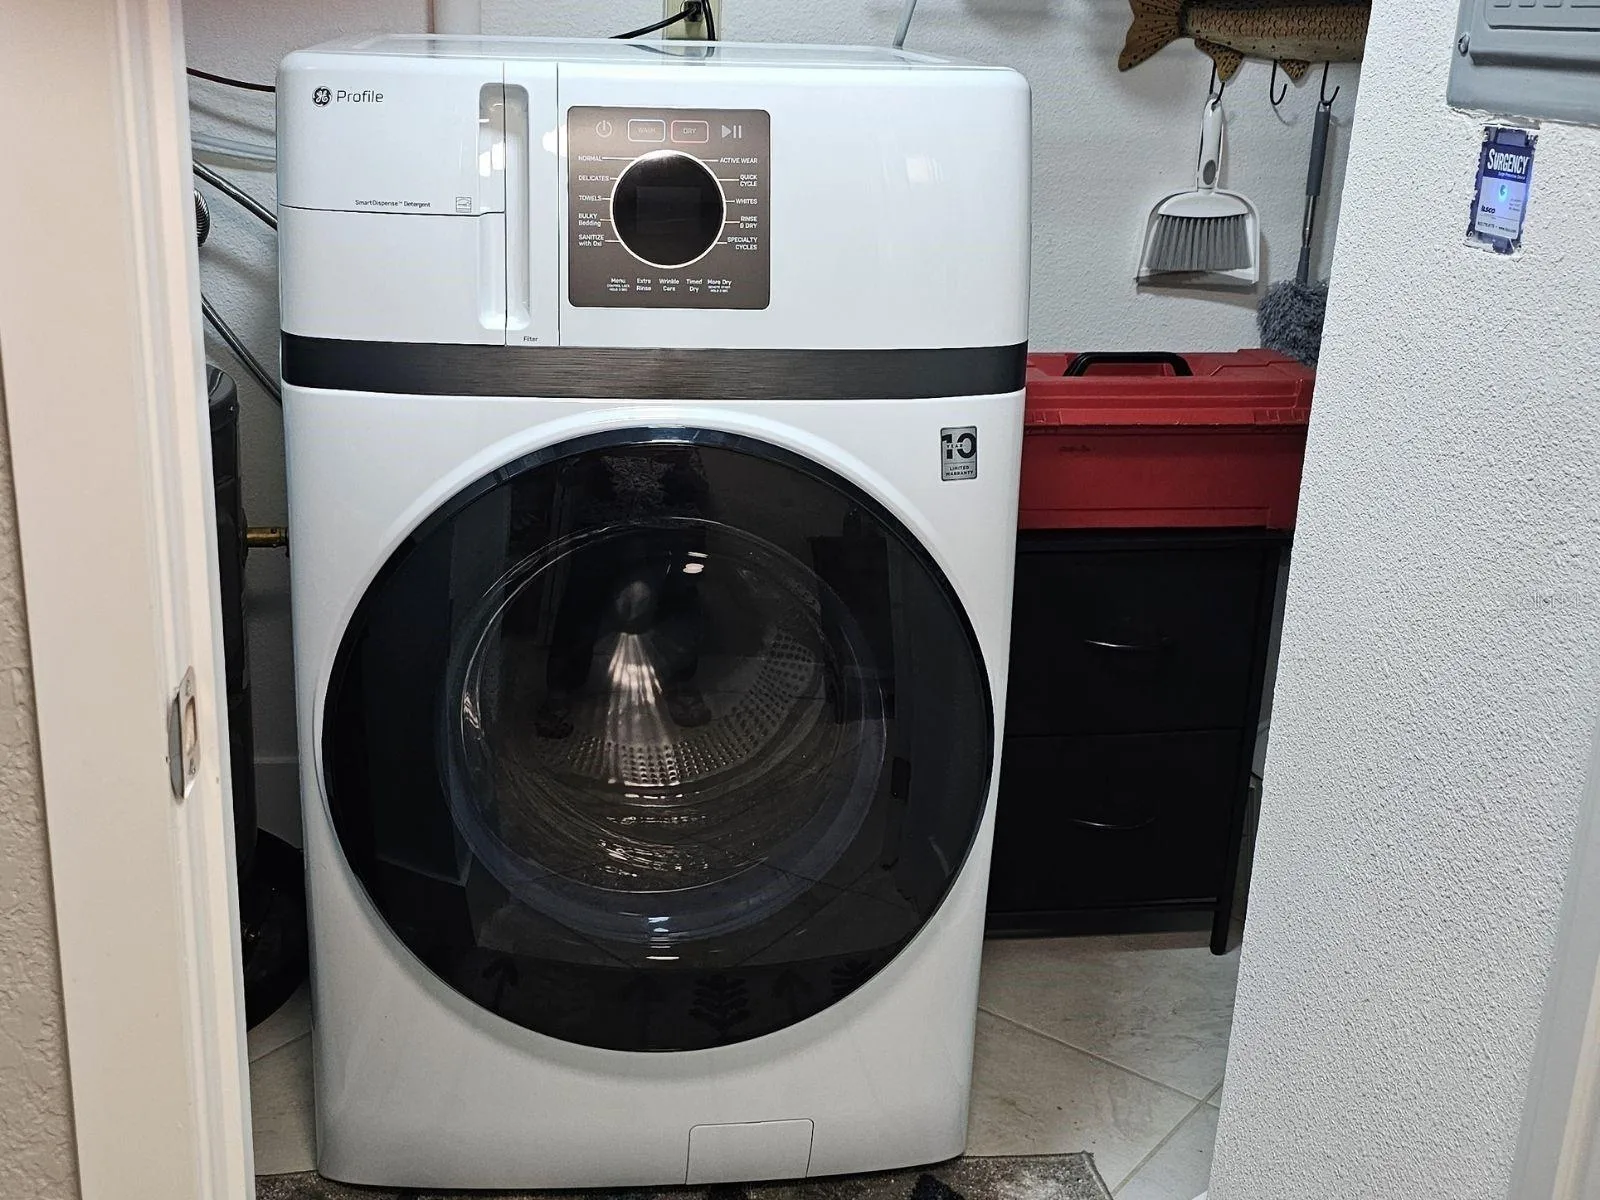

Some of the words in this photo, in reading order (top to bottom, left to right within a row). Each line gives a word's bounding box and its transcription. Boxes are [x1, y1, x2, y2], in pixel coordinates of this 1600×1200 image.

[336, 90, 384, 103] Profile
[1487, 148, 1530, 174] SURGENCY
[403, 200, 431, 208] Detergent
[942, 433, 977, 459] 10
